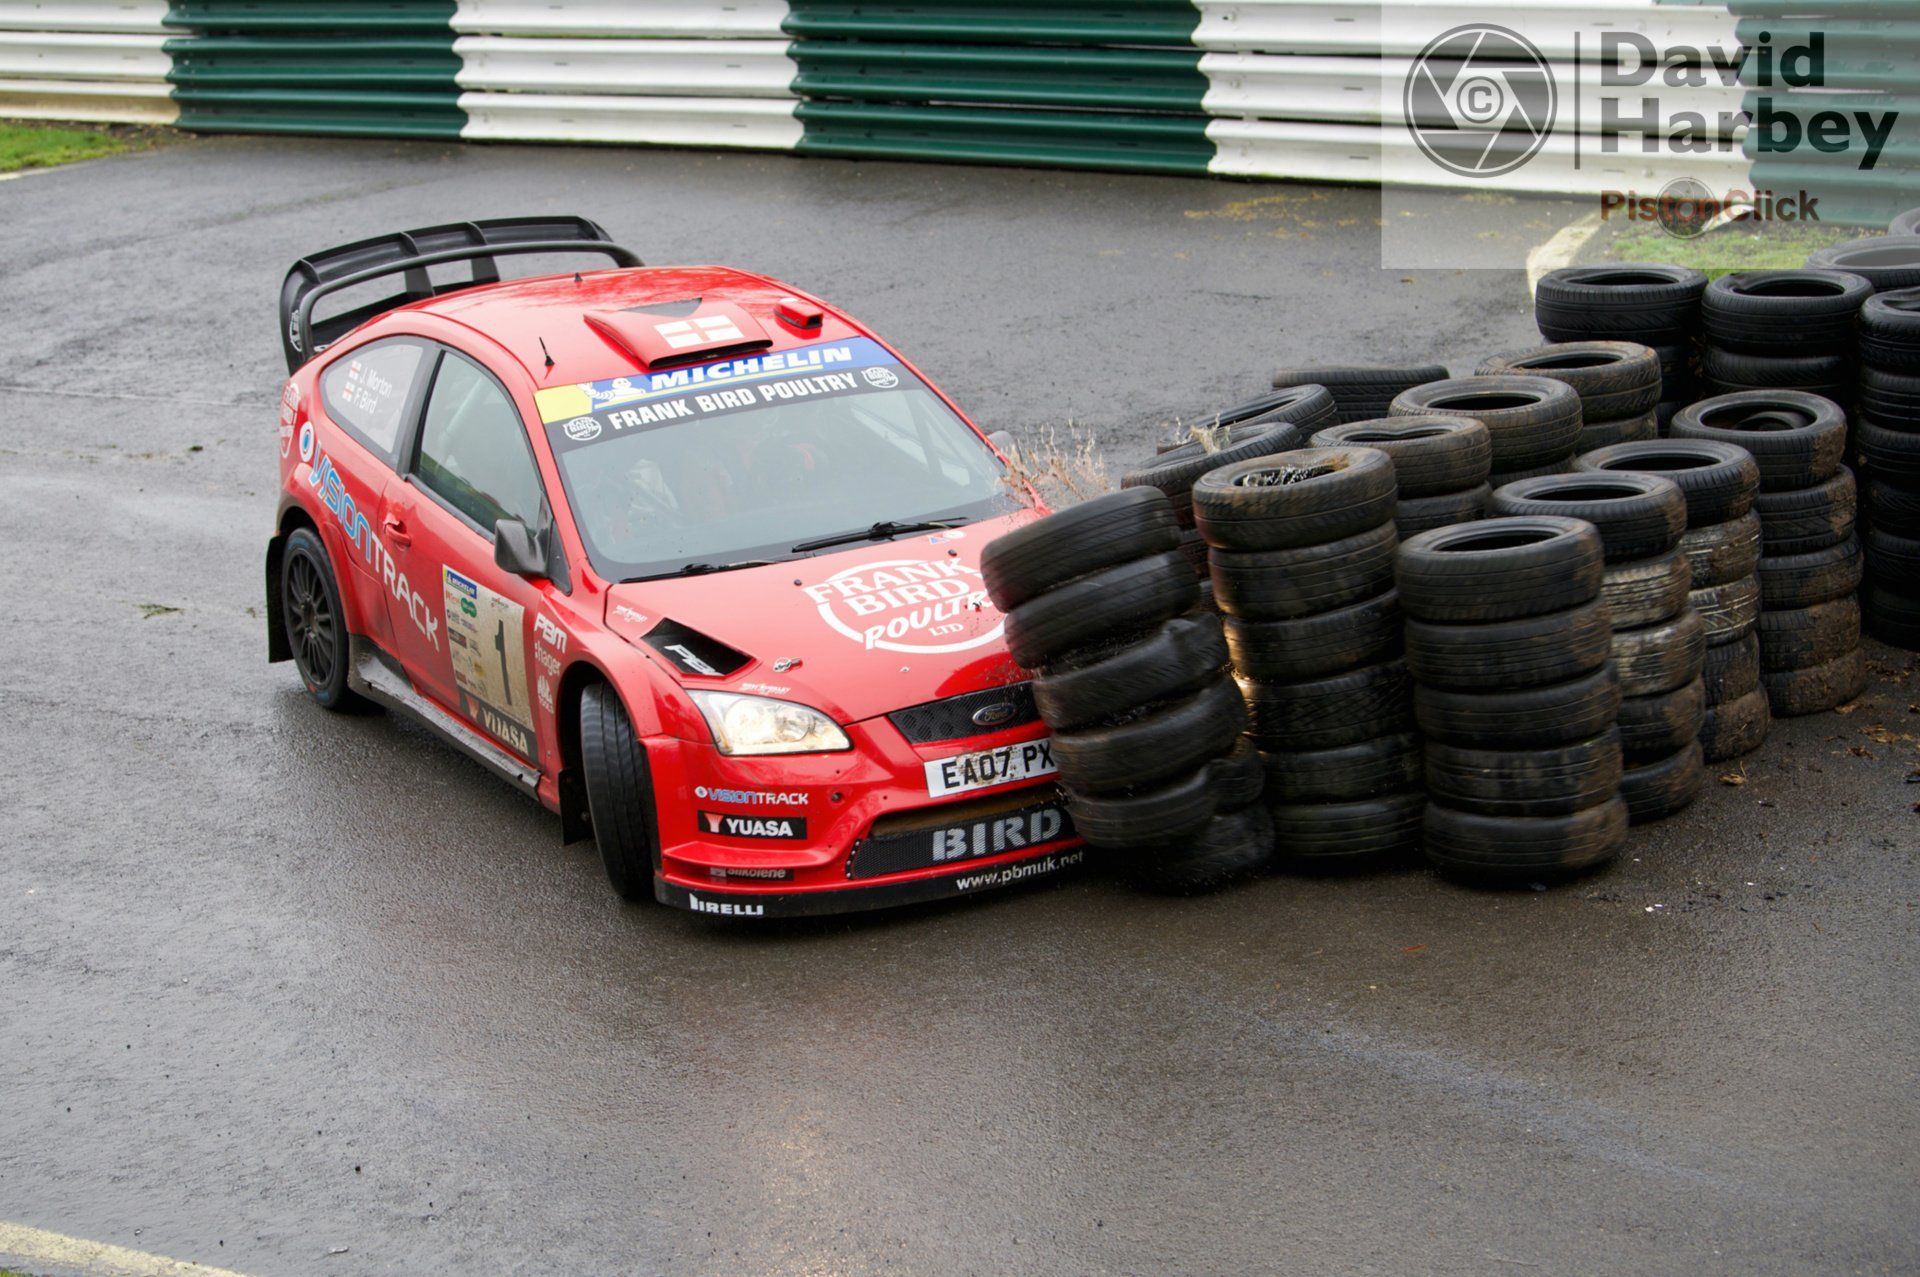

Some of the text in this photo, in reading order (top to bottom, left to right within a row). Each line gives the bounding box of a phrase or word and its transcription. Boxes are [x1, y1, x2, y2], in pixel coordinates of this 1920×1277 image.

[651, 347, 852, 390] MICHELIN
[608, 372, 858, 430] FRANK BIRD POULTRY
[801, 558, 974, 605] FRANK
[843, 578, 971, 616] BIRD
[864, 588, 994, 650] POULTR
[929, 623, 965, 637] LTD
[495, 619, 512, 706] 1
[482, 707, 529, 756] YUASA
[941, 750, 1011, 788] EA07
[726, 818, 793, 836] YUASA
[932, 809, 1061, 860] BIRD
[956, 850, 1083, 890] www.pbmuk.net
[689, 893, 764, 915] PIRELLI
